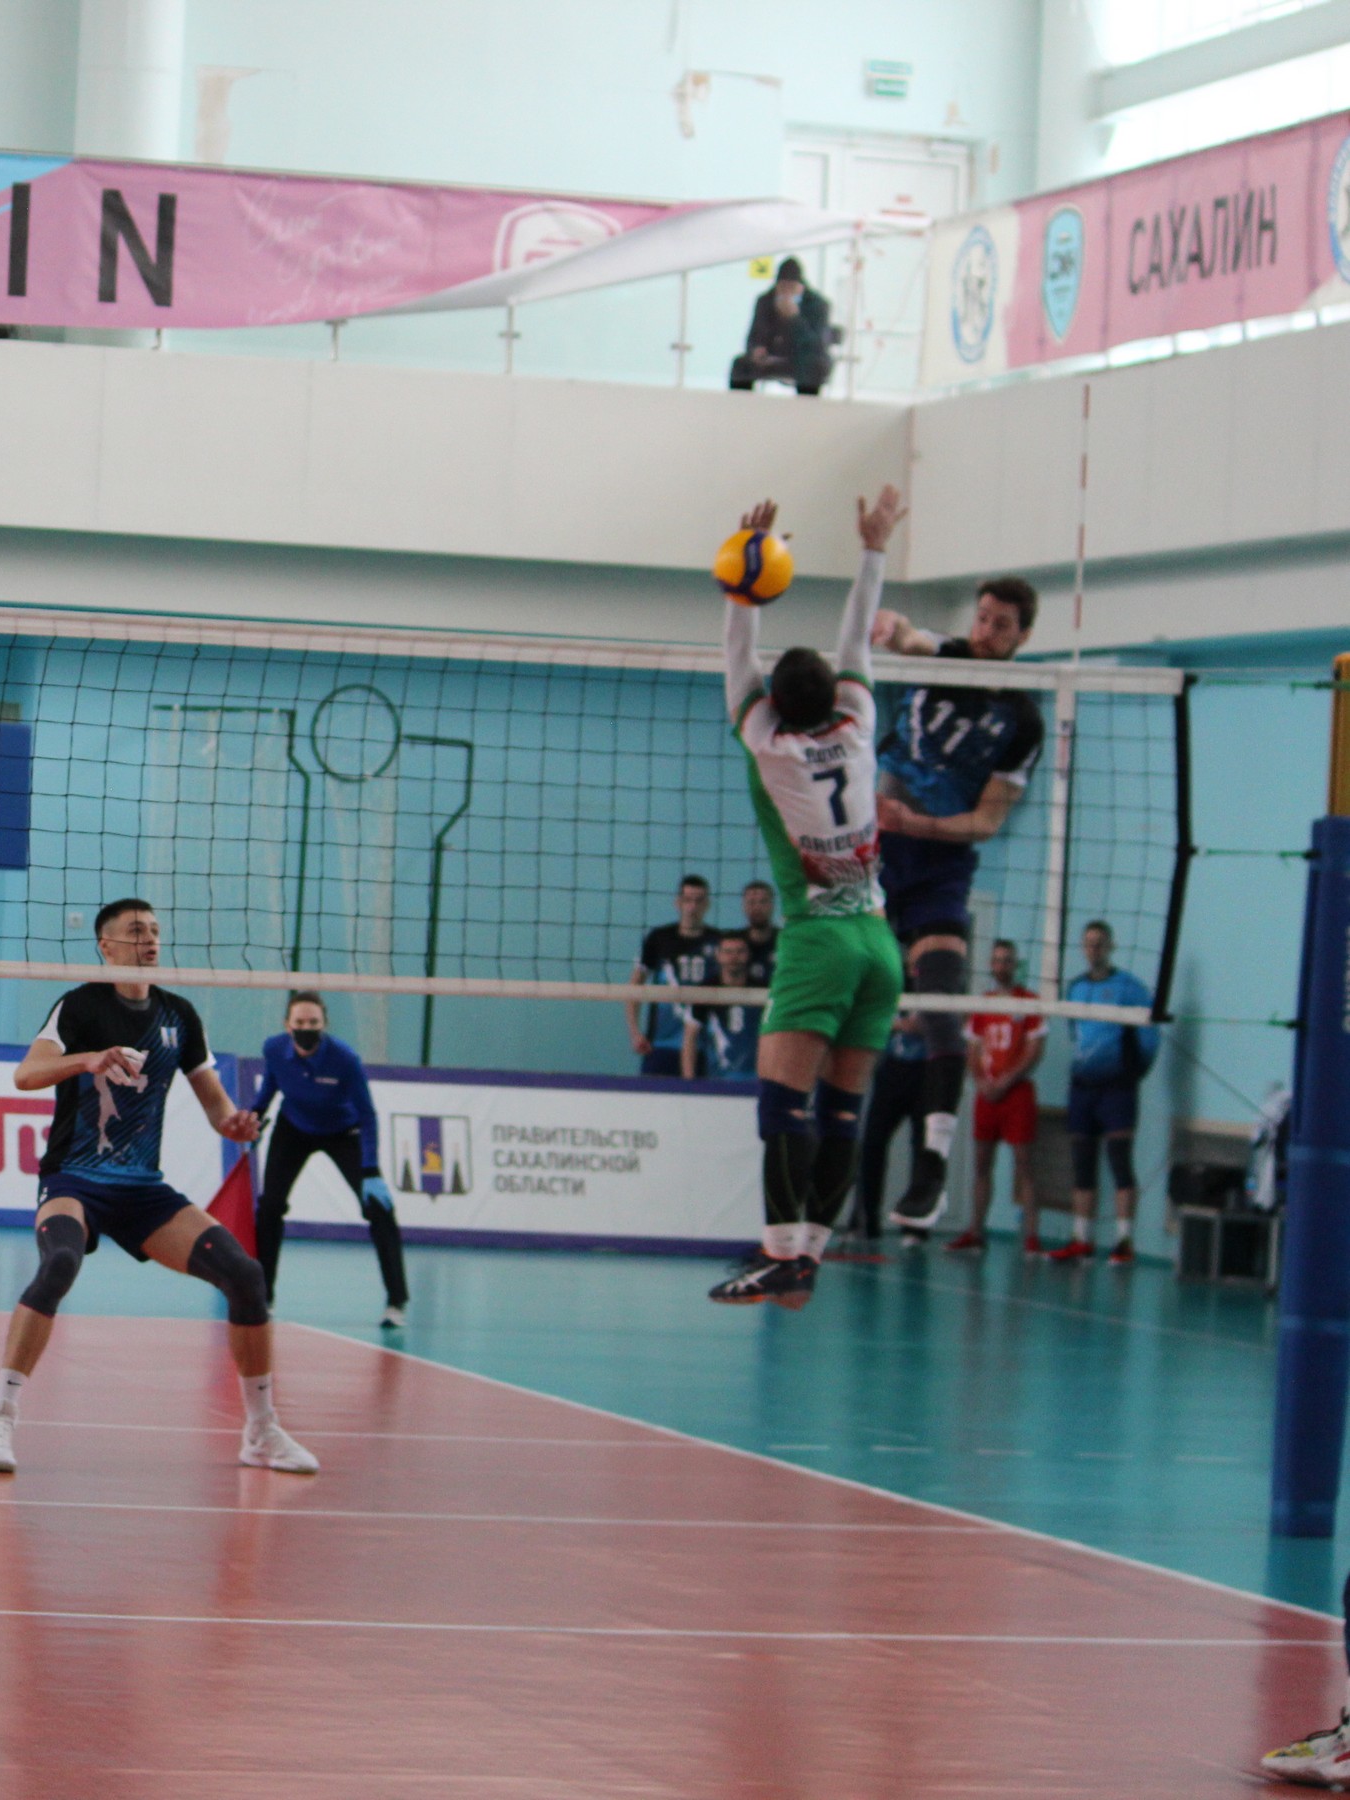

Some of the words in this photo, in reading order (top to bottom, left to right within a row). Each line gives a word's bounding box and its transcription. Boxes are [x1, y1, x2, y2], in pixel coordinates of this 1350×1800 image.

[1128, 183, 1278, 295] САХАЛИН
[812, 766, 848, 827] 7
[492, 1124, 659, 1150] ПРАВИТЕЛЬСТВО
[493, 1149, 641, 1173] САХАЛИНСКОЙ
[494, 1174, 587, 1196] ОБЛАСТИ
